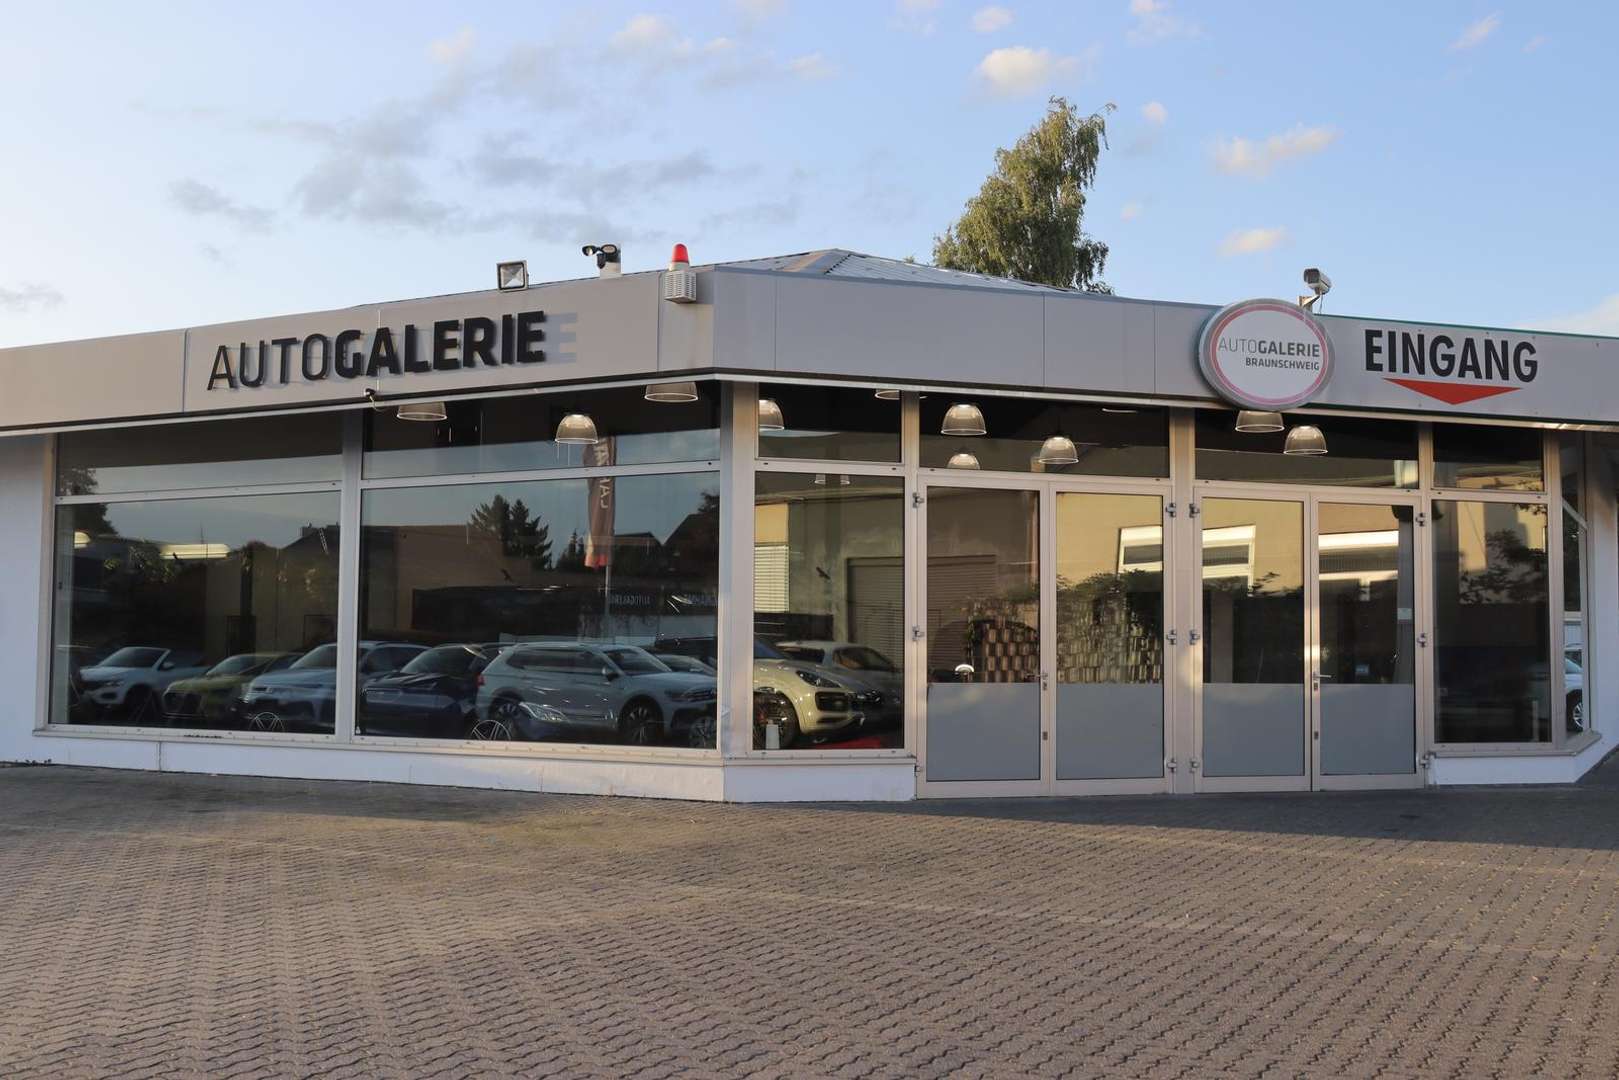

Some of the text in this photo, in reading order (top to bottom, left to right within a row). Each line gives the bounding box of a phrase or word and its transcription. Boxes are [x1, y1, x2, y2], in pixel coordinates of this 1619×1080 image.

[207, 310, 546, 391] AUTOGALERIE
[1219, 337, 1320, 357] AUTOGALERIE
[1245, 357, 1320, 370] BRAUNSCHWEIG
[1365, 329, 1538, 382] EINGANG
